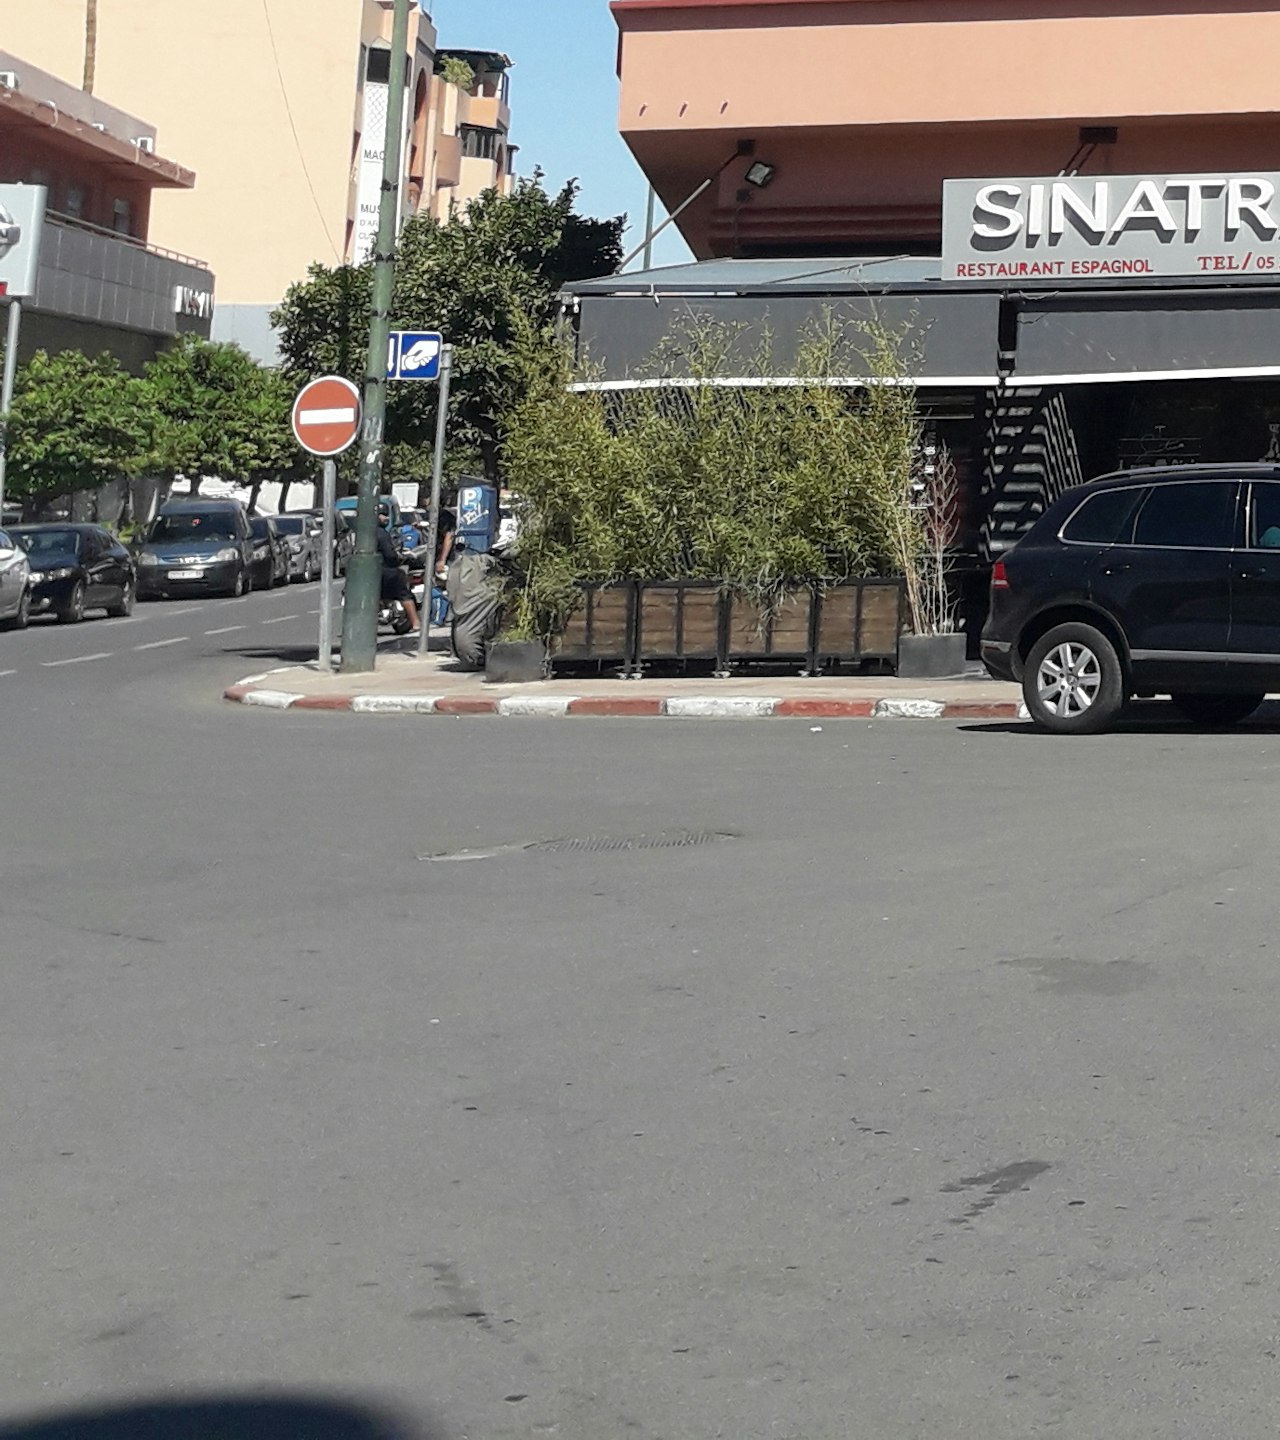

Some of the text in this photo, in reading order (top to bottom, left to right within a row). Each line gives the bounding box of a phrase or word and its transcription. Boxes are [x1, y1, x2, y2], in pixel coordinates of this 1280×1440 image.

[956, 257, 1154, 278] RESTAURANT ESPAGNOL
[1256, 256, 1277, 271] 05
